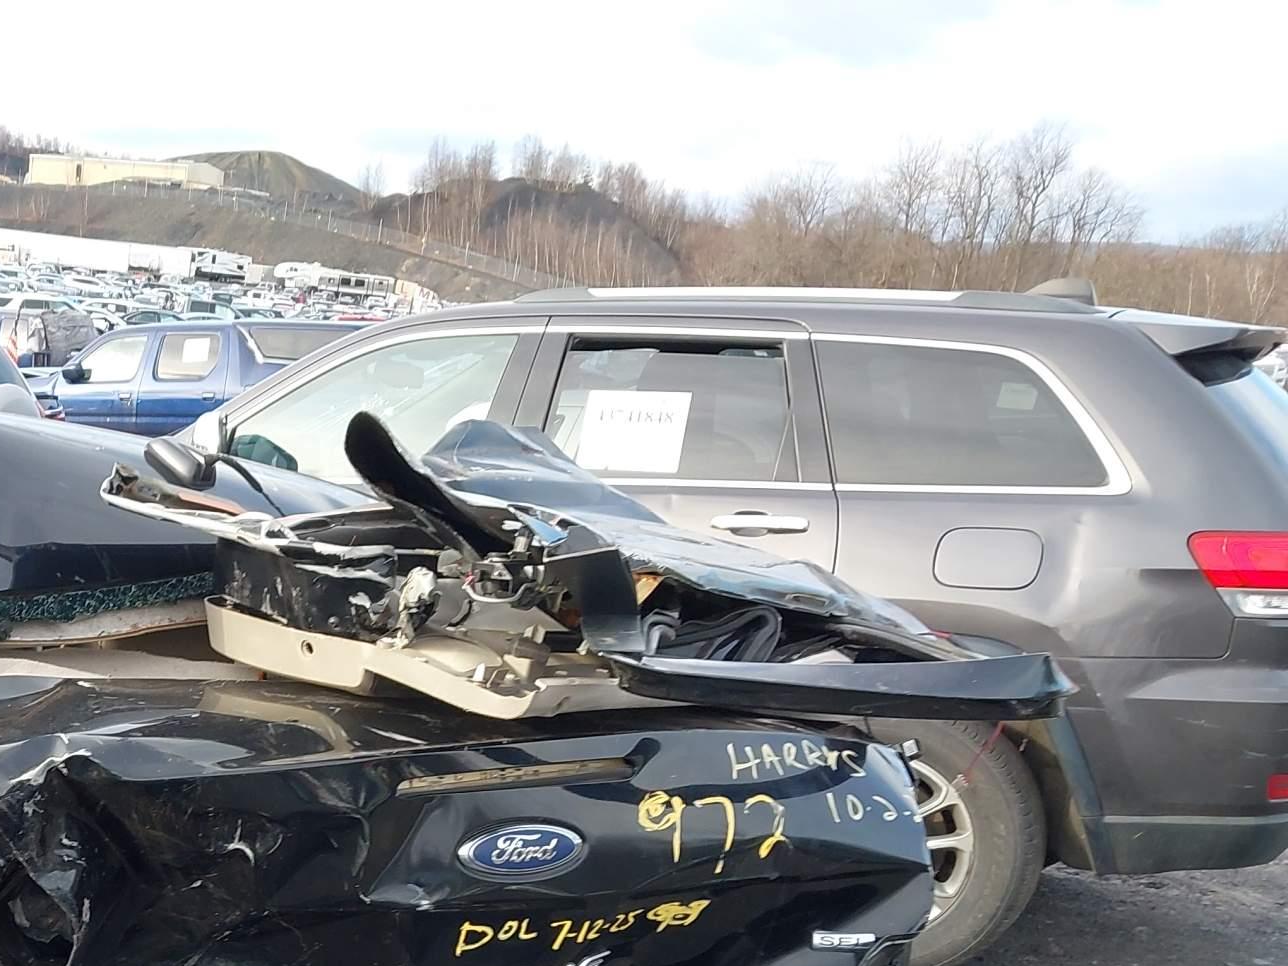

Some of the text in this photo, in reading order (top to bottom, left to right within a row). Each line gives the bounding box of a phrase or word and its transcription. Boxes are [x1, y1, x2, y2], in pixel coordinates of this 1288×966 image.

[491, 833, 559, 865] Ford
[638, 791, 794, 874] 972
[455, 918, 538, 957] DOL
[550, 909, 645, 950] 7-12-25
